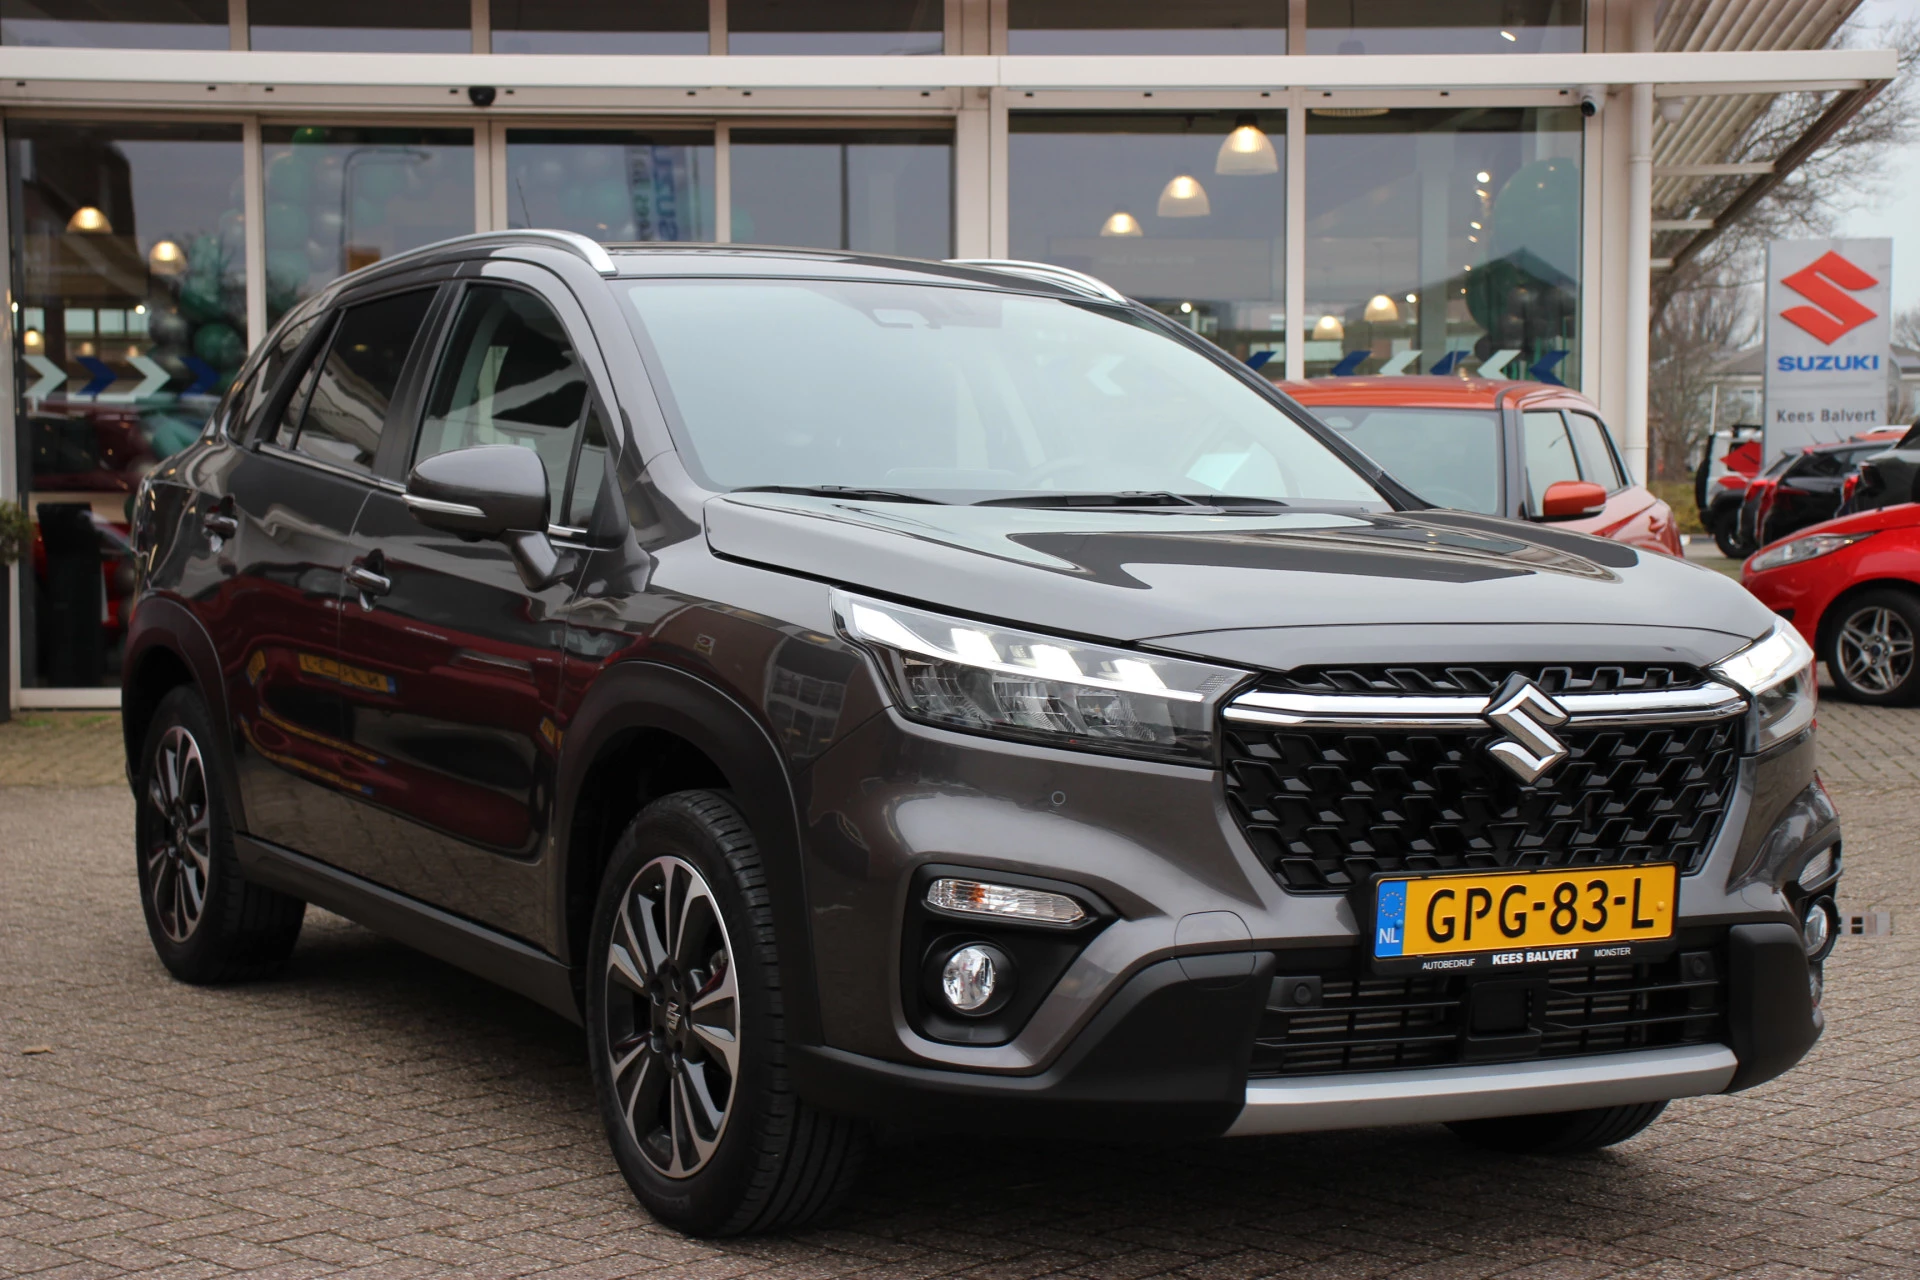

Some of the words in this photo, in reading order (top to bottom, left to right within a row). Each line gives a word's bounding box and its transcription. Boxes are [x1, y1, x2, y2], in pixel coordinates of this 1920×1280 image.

[1777, 355, 1880, 372] SUZUKI
[1776, 408, 1815, 422] Kees
[1821, 407, 1877, 422] Balvert
[1426, 878, 1654, 943] GPG-83-L
[1378, 927, 1400, 945] NL
[1421, 958, 1476, 970] AUTOBEDRIJF
[1492, 952, 1524, 965] KEES
[1526, 948, 1579, 963] BALVERT
[1593, 947, 1632, 957] MONSTER
